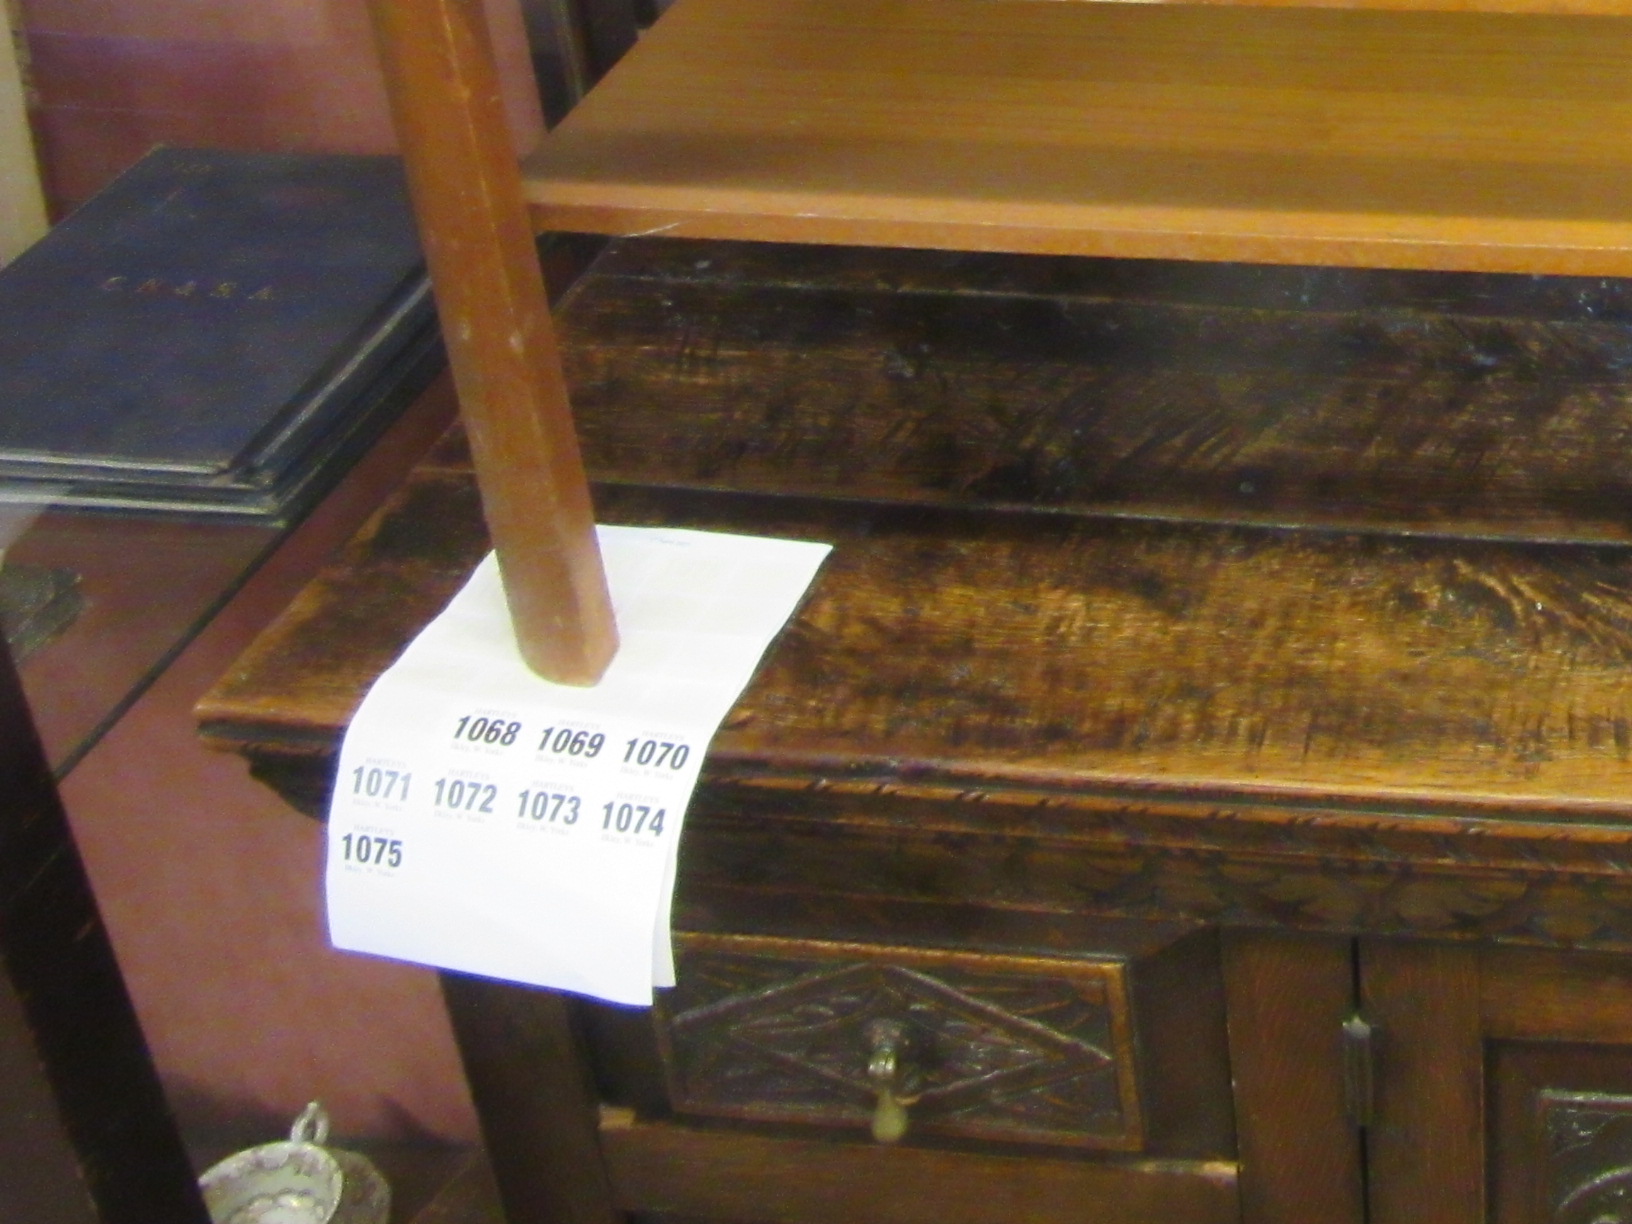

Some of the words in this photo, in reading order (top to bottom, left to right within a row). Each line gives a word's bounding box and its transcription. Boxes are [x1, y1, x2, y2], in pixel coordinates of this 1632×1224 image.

[452, 715, 522, 747] 1068
[537, 726, 606, 758] 1069
[622, 738, 690, 771] 1070
[353, 765, 413, 802] 1071
[433, 777, 497, 815] 1072
[518, 789, 581, 826] 1073
[602, 801, 666, 838] 1074
[342, 833, 403, 869] 1075
